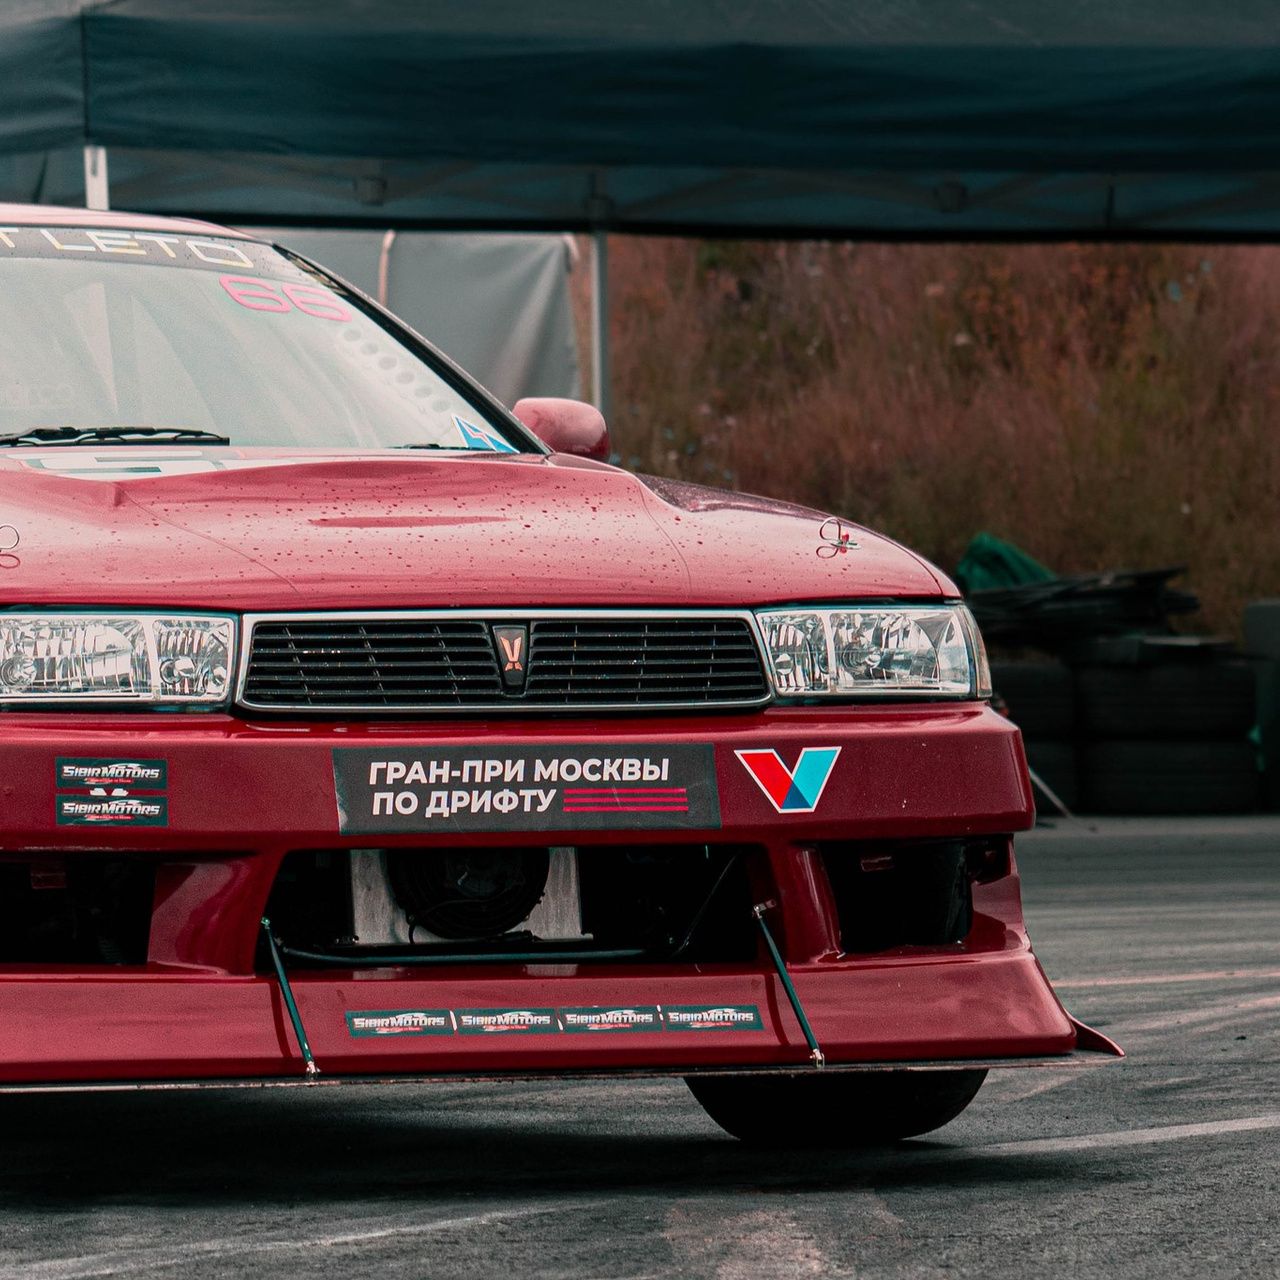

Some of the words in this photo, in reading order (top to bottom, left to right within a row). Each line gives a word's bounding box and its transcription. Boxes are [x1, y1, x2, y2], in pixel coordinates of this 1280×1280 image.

[40, 229, 254, 268] LETO
[220, 275, 352, 322] 66
[369, 759, 525, 785] ГРАН-ПРИ
[533, 758, 669, 782] МОСКВЫ
[372, 791, 419, 815] ПО
[425, 788, 557, 818] ДРИФТУ
